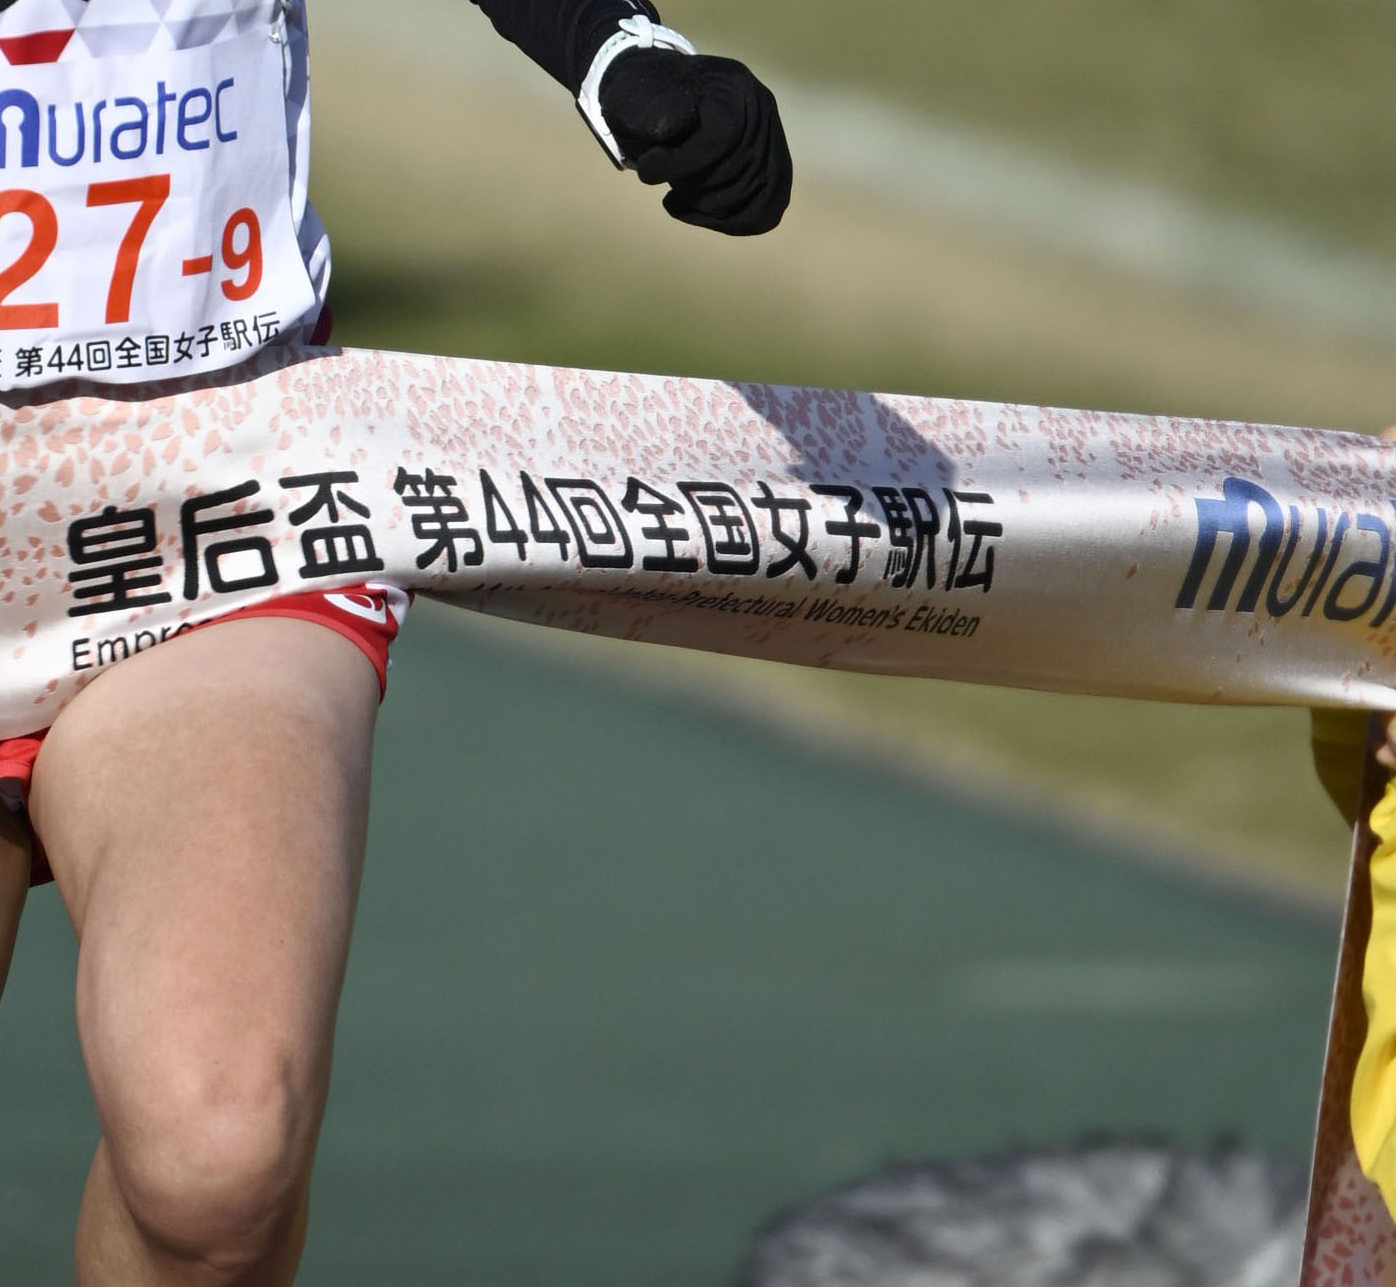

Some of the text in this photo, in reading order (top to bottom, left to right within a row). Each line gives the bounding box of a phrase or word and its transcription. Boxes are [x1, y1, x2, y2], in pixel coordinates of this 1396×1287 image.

[15, 311, 280, 378] 第44回全国女子駅伝
[66, 465, 1004, 618] 皇后盃 第44回全国女子駅伝
[72, 618, 212, 672] Empr
[804, 597, 906, 629] Women's
[905, 605, 981, 638] Ekiden
